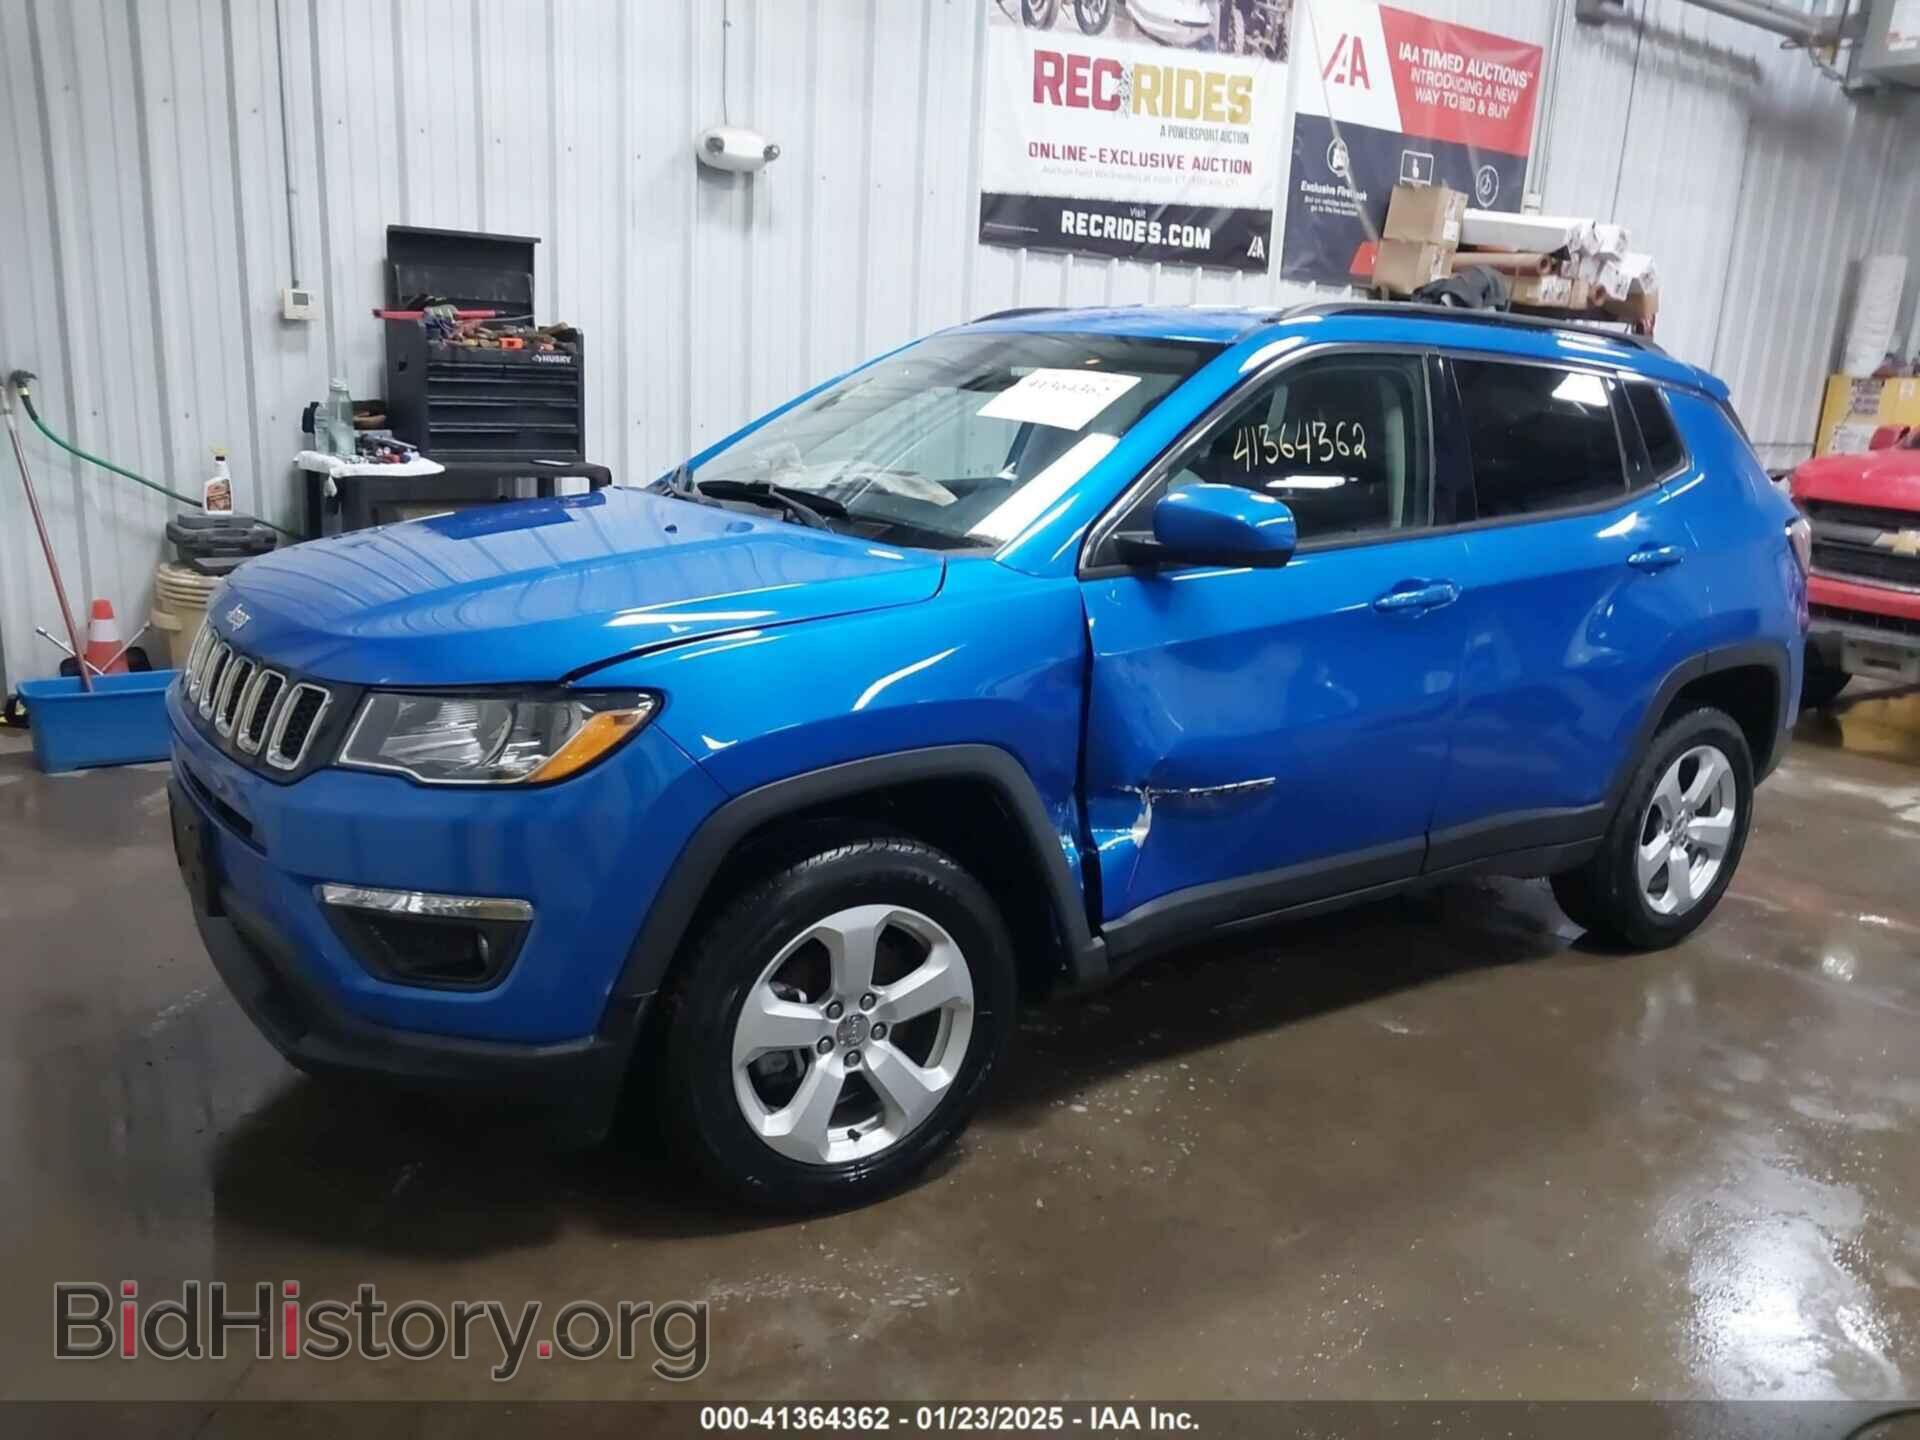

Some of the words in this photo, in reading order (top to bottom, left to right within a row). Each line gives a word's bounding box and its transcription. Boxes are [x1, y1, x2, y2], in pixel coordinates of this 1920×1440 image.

[1398, 42, 1420, 63] IAA
[1421, 47, 1464, 74] TIMED
[1410, 67, 1482, 96] INTRODUCING
[1483, 83, 1493, 98] A
[1494, 86, 1520, 105] NEW
[1415, 87, 1441, 105] WAY
[1442, 92, 1459, 109] TO
[1459, 96, 1476, 113] BID
[1487, 102, 1511, 119] BUY
[1028, 141, 1185, 170] ONLINE-EXCLUSIVE
[1191, 155, 1253, 175] AUCTION
[1060, 210, 1212, 250] RECRIDES.COM
[1232, 421, 1368, 473] 41364362
